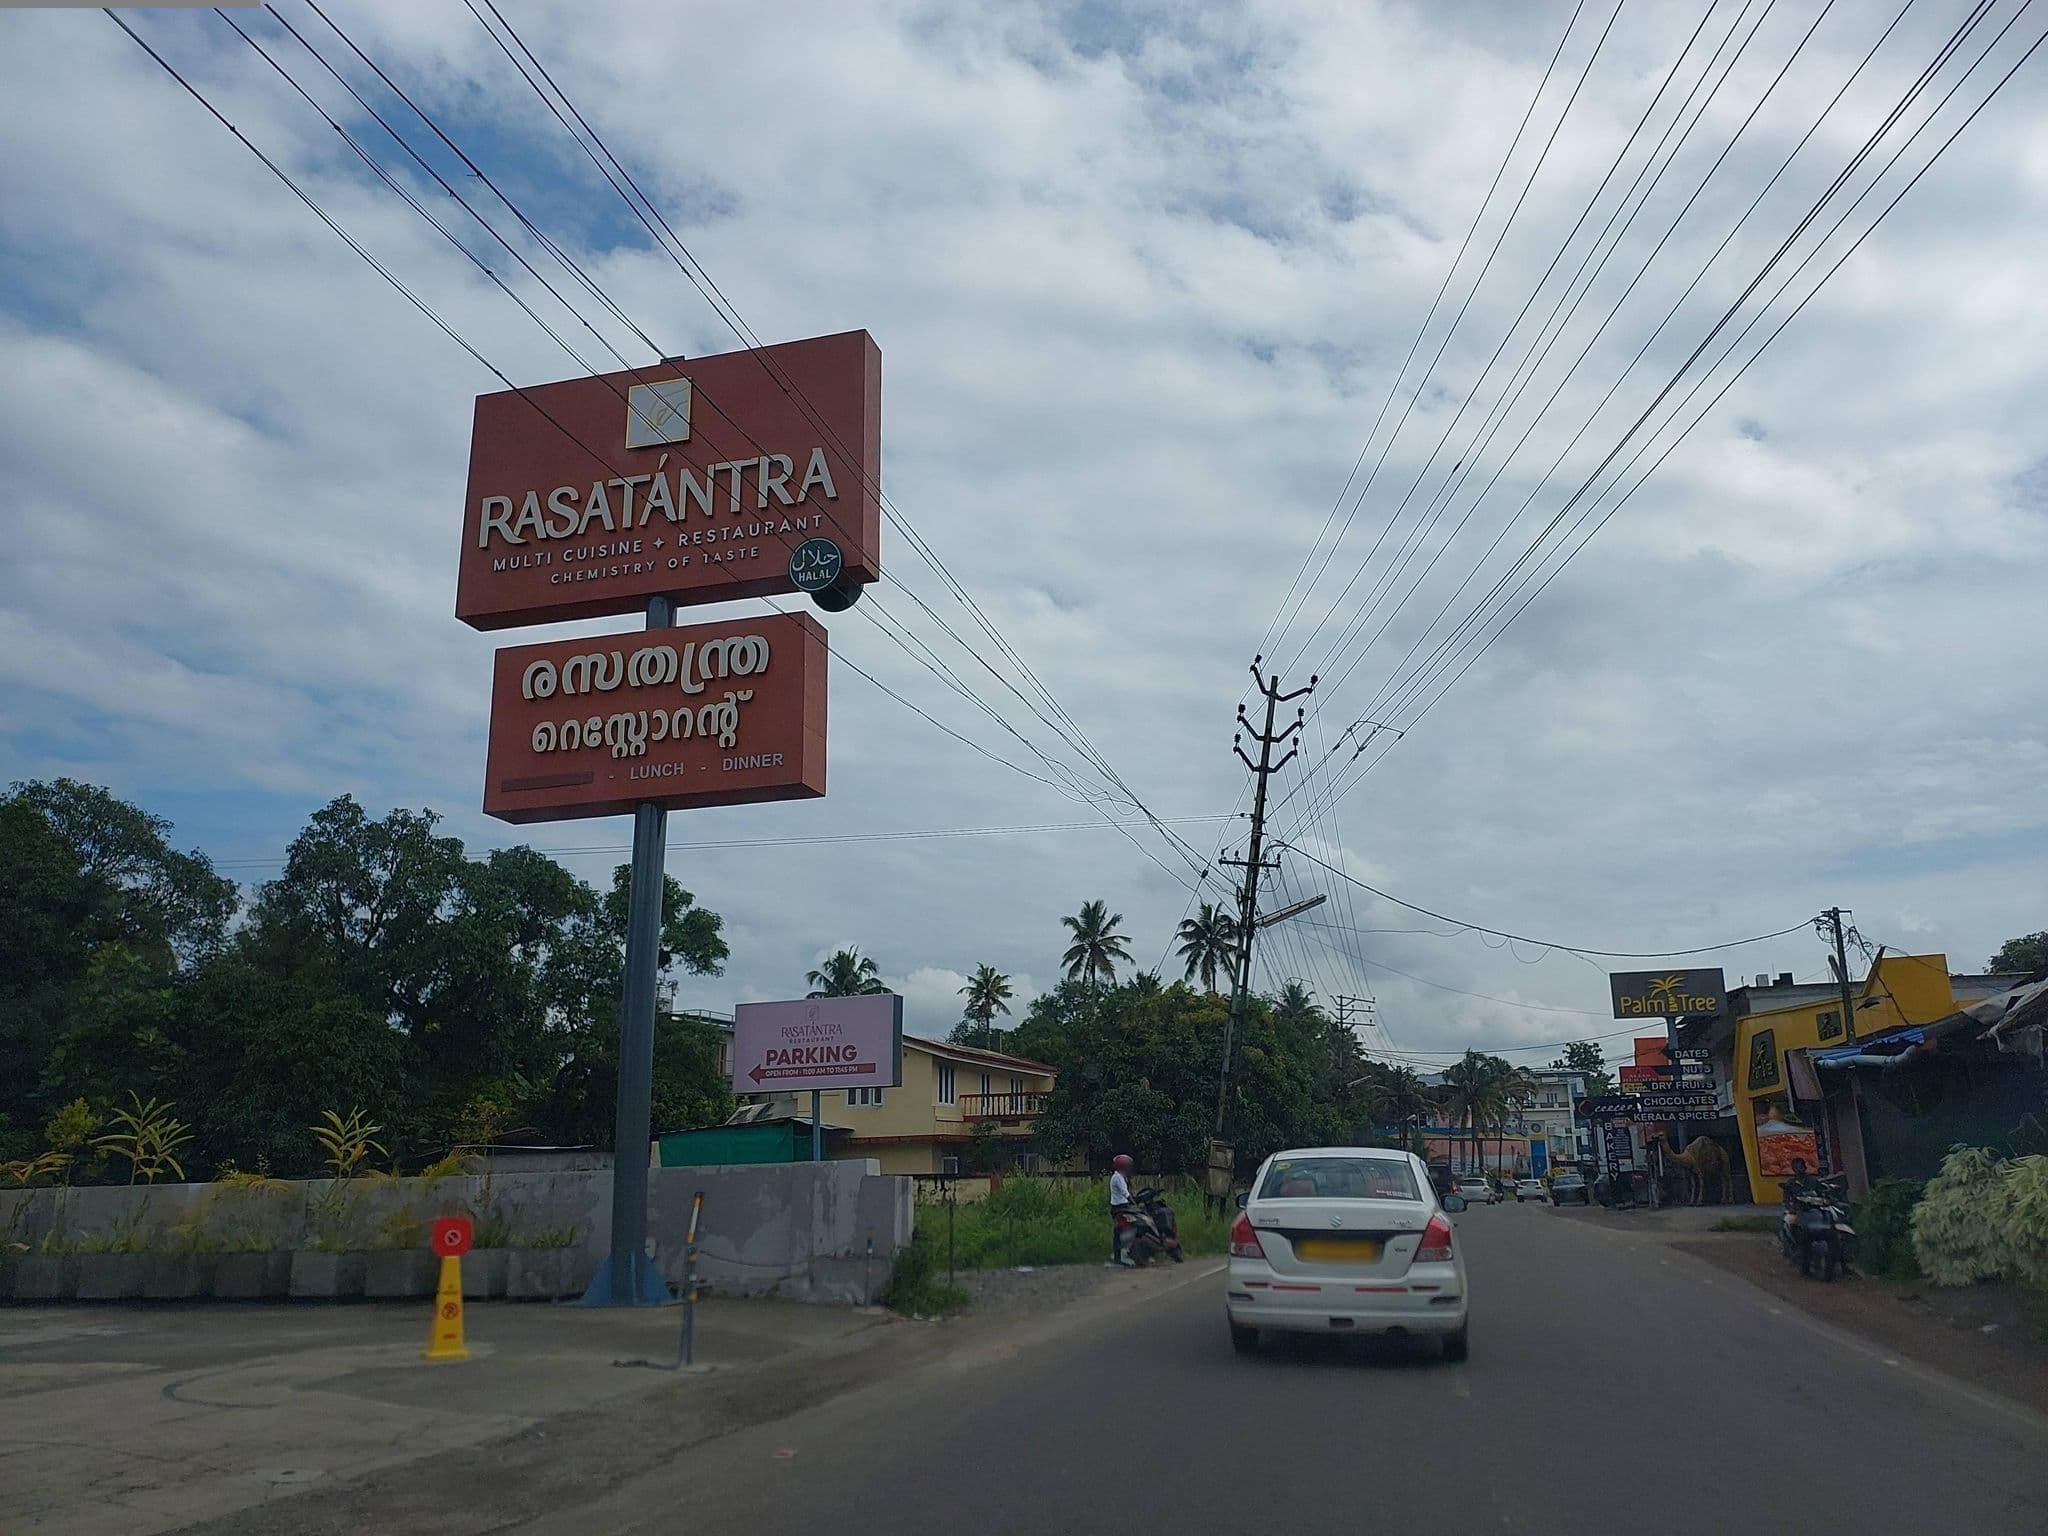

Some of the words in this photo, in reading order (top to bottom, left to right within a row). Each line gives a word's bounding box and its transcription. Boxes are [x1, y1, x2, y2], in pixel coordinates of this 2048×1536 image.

[478, 447, 838, 548] RASATÁNTRA
[493, 552, 552, 572] MULTI
[562, 540, 643, 562] CUISINE
[678, 514, 823, 546] RESTAURANT
[550, 560, 656, 584] CHEMISTRY
[668, 555, 691, 569] OF
[702, 545, 760, 565] TASTE
[798, 569, 832, 582] HALAL
[522, 634, 771, 700] രസതന്ത്ര
[629, 762, 685, 780] LUNCH
[722, 752, 784, 771] DINNER
[1619, 995, 1665, 1014] Palm
[1677, 993, 1717, 1012] Tree
[766, 1044, 858, 1066] PARKING
[1674, 1049, 1710, 1059] DATES
[1651, 1082, 1673, 1090] DRY
[1643, 1096, 1715, 1106] CHOCOLATES
[1633, 1112, 1677, 1122] KERALA
[1678, 1111, 1717, 1120] SPICES
[1604, 1122, 1619, 1182] BAKERY
